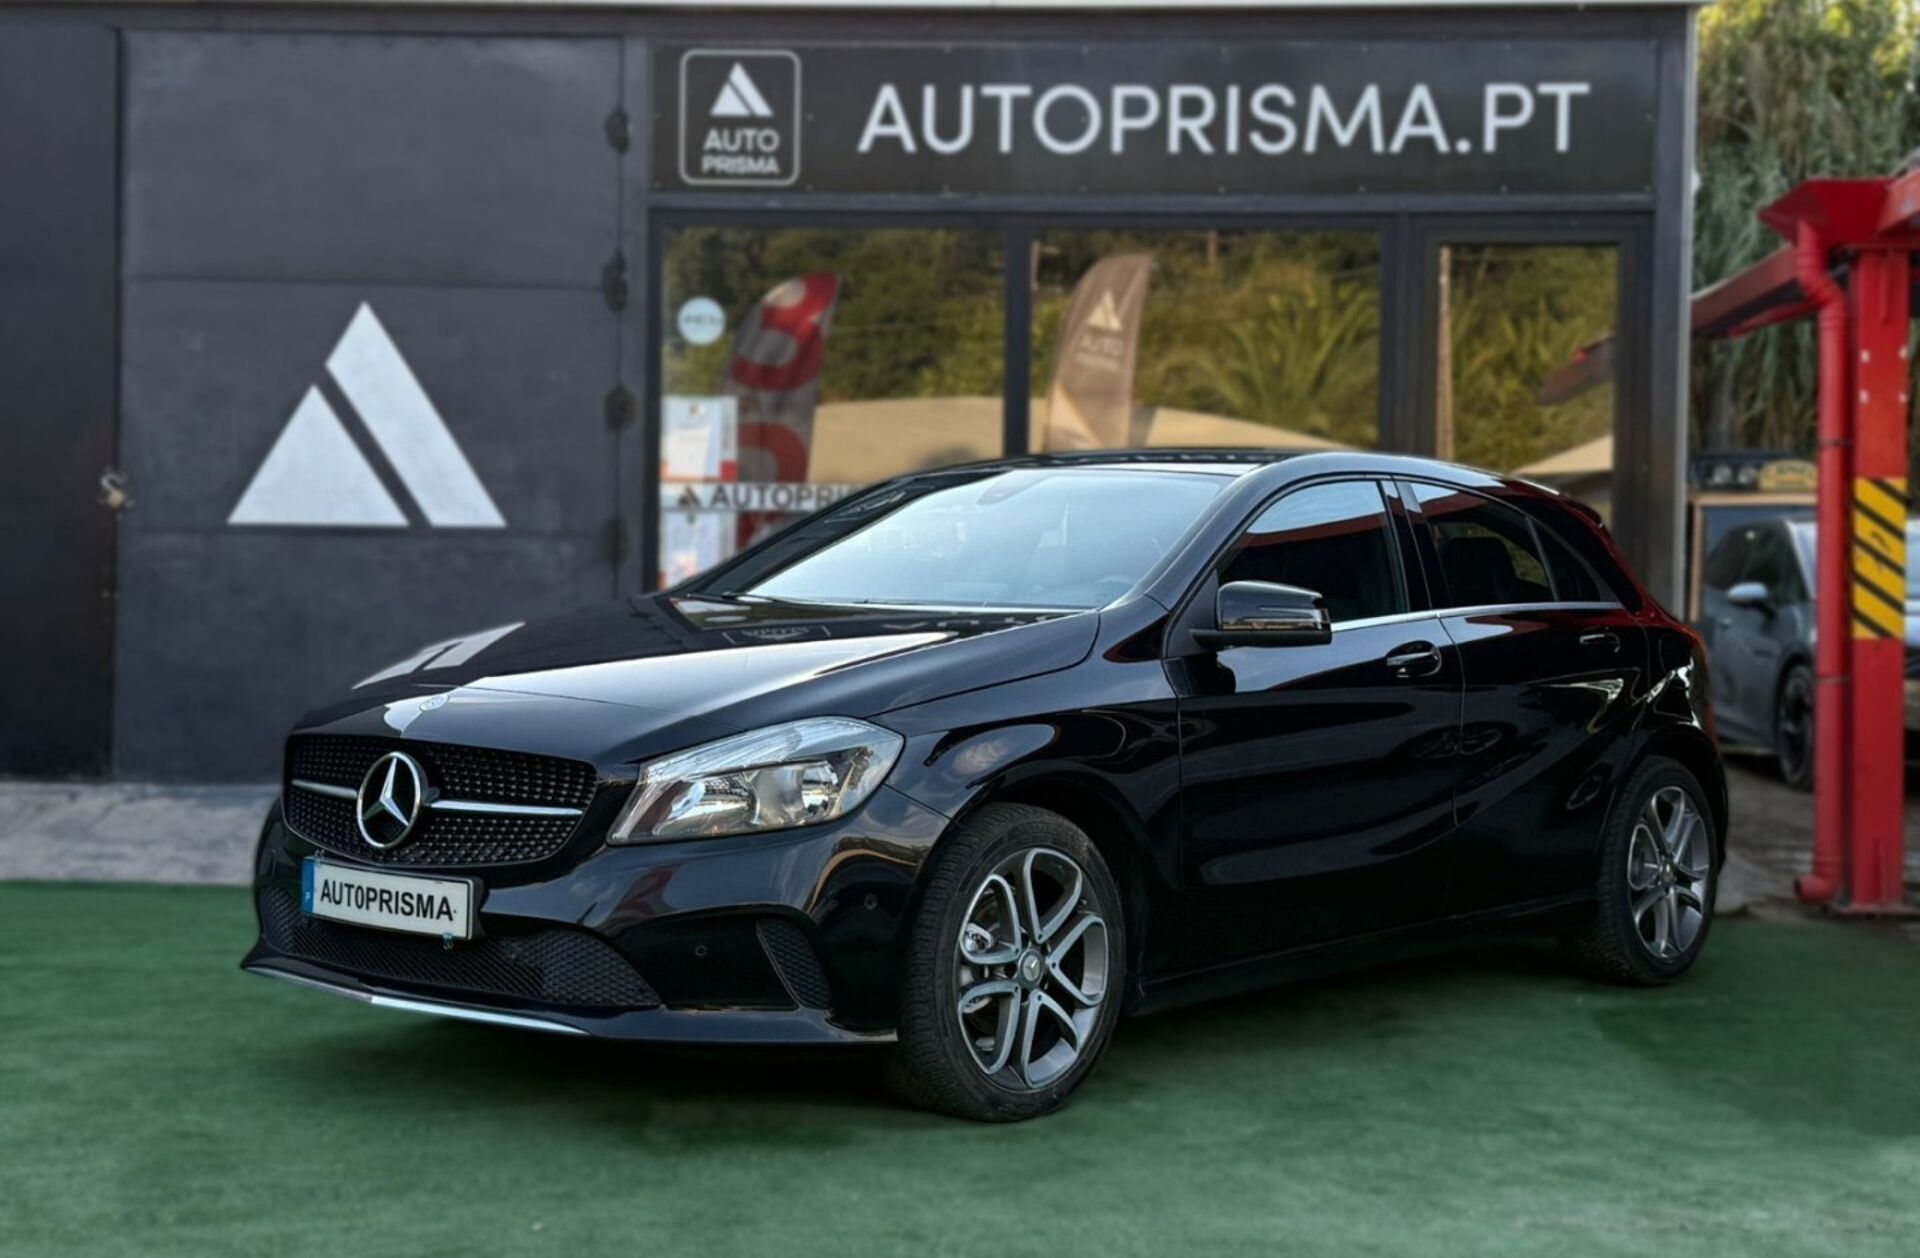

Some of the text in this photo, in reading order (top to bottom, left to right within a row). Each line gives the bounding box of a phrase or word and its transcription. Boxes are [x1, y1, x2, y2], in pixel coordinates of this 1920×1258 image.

[857, 82, 1590, 154] AUTOPRISMA.PT
[703, 127, 780, 152] AUTO
[701, 154, 780, 174] PRISMA
[320, 878, 454, 922] AUTOPRISMA
